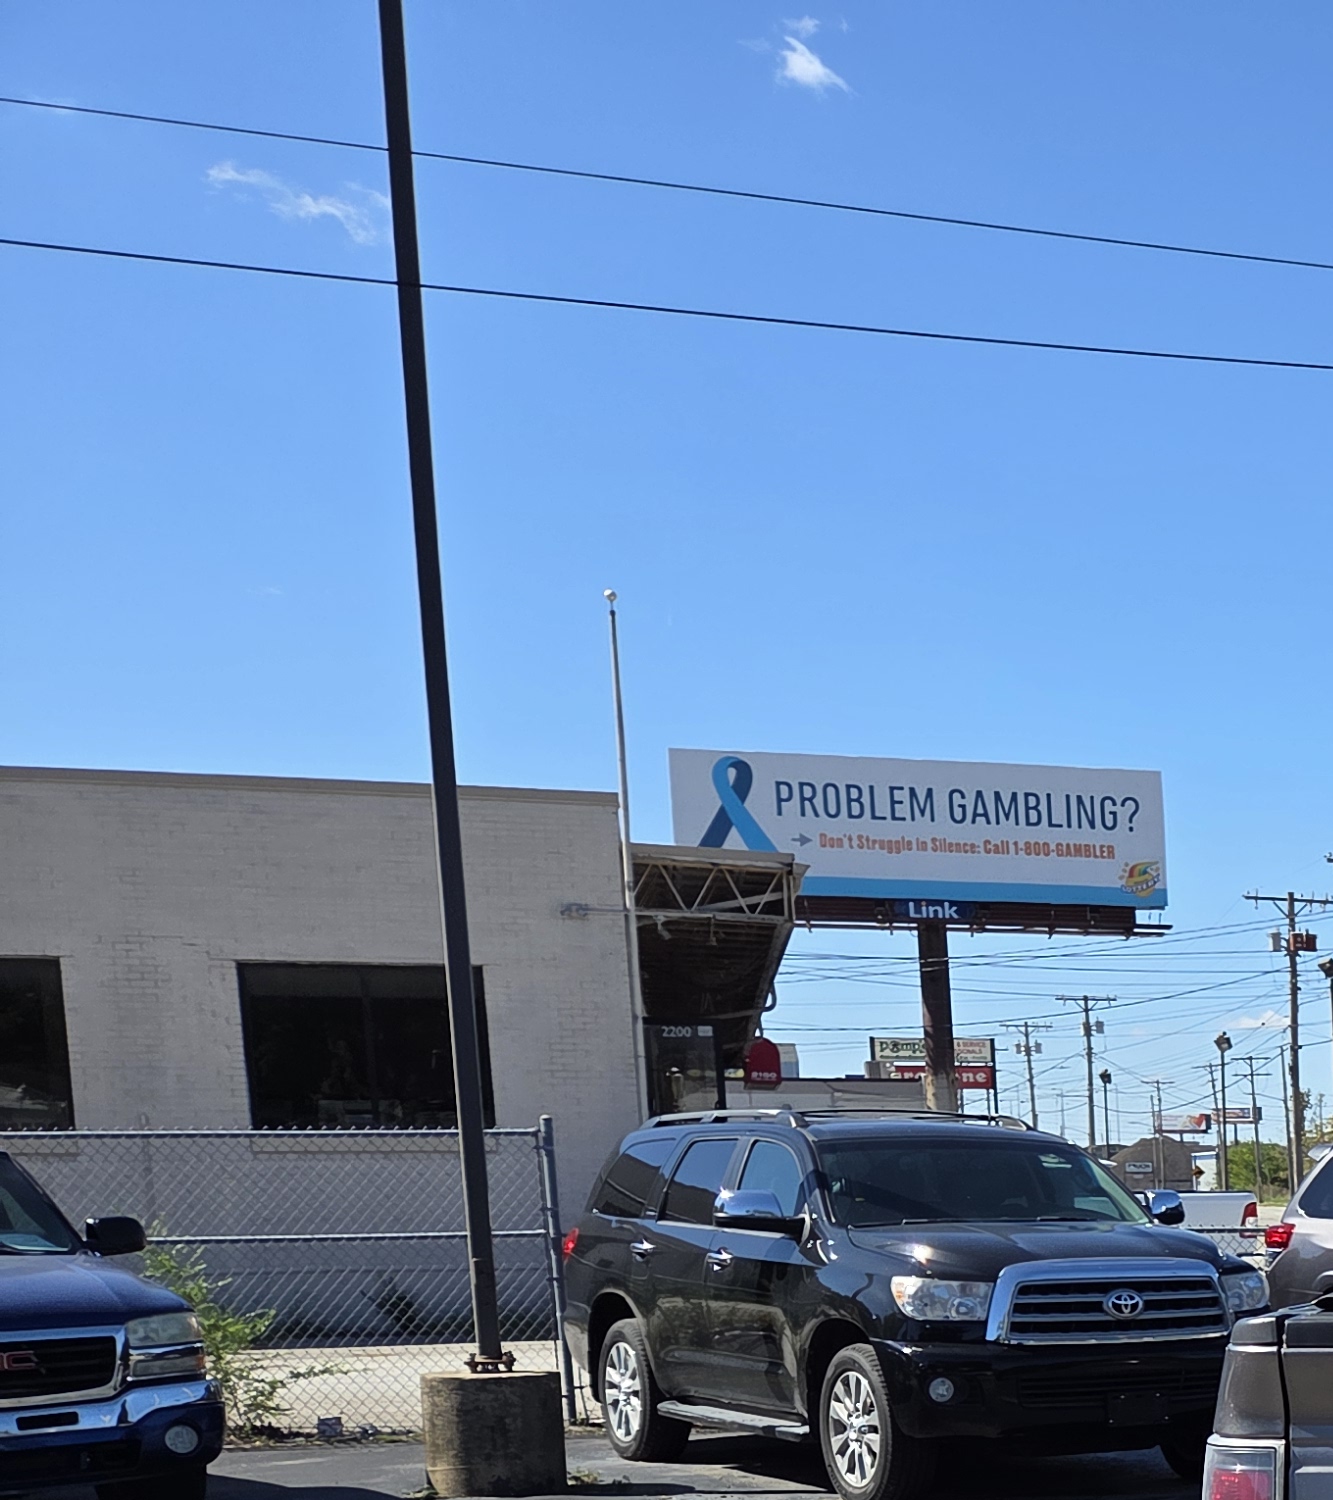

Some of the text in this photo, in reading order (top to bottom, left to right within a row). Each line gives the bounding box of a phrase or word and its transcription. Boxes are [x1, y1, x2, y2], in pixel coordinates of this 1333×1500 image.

[775, 780, 1140, 833] PROBLEM GAMBLING?
[819, 832, 854, 850] Don't
[856, 833, 913, 854] Struggle
[931, 837, 981, 855] Silence:
[983, 839, 1010, 856] Call
[1012, 841, 1116, 860] 1-800-GAMBLER
[909, 901, 959, 919] Link
[661, 1026, 692, 1037] 2200
